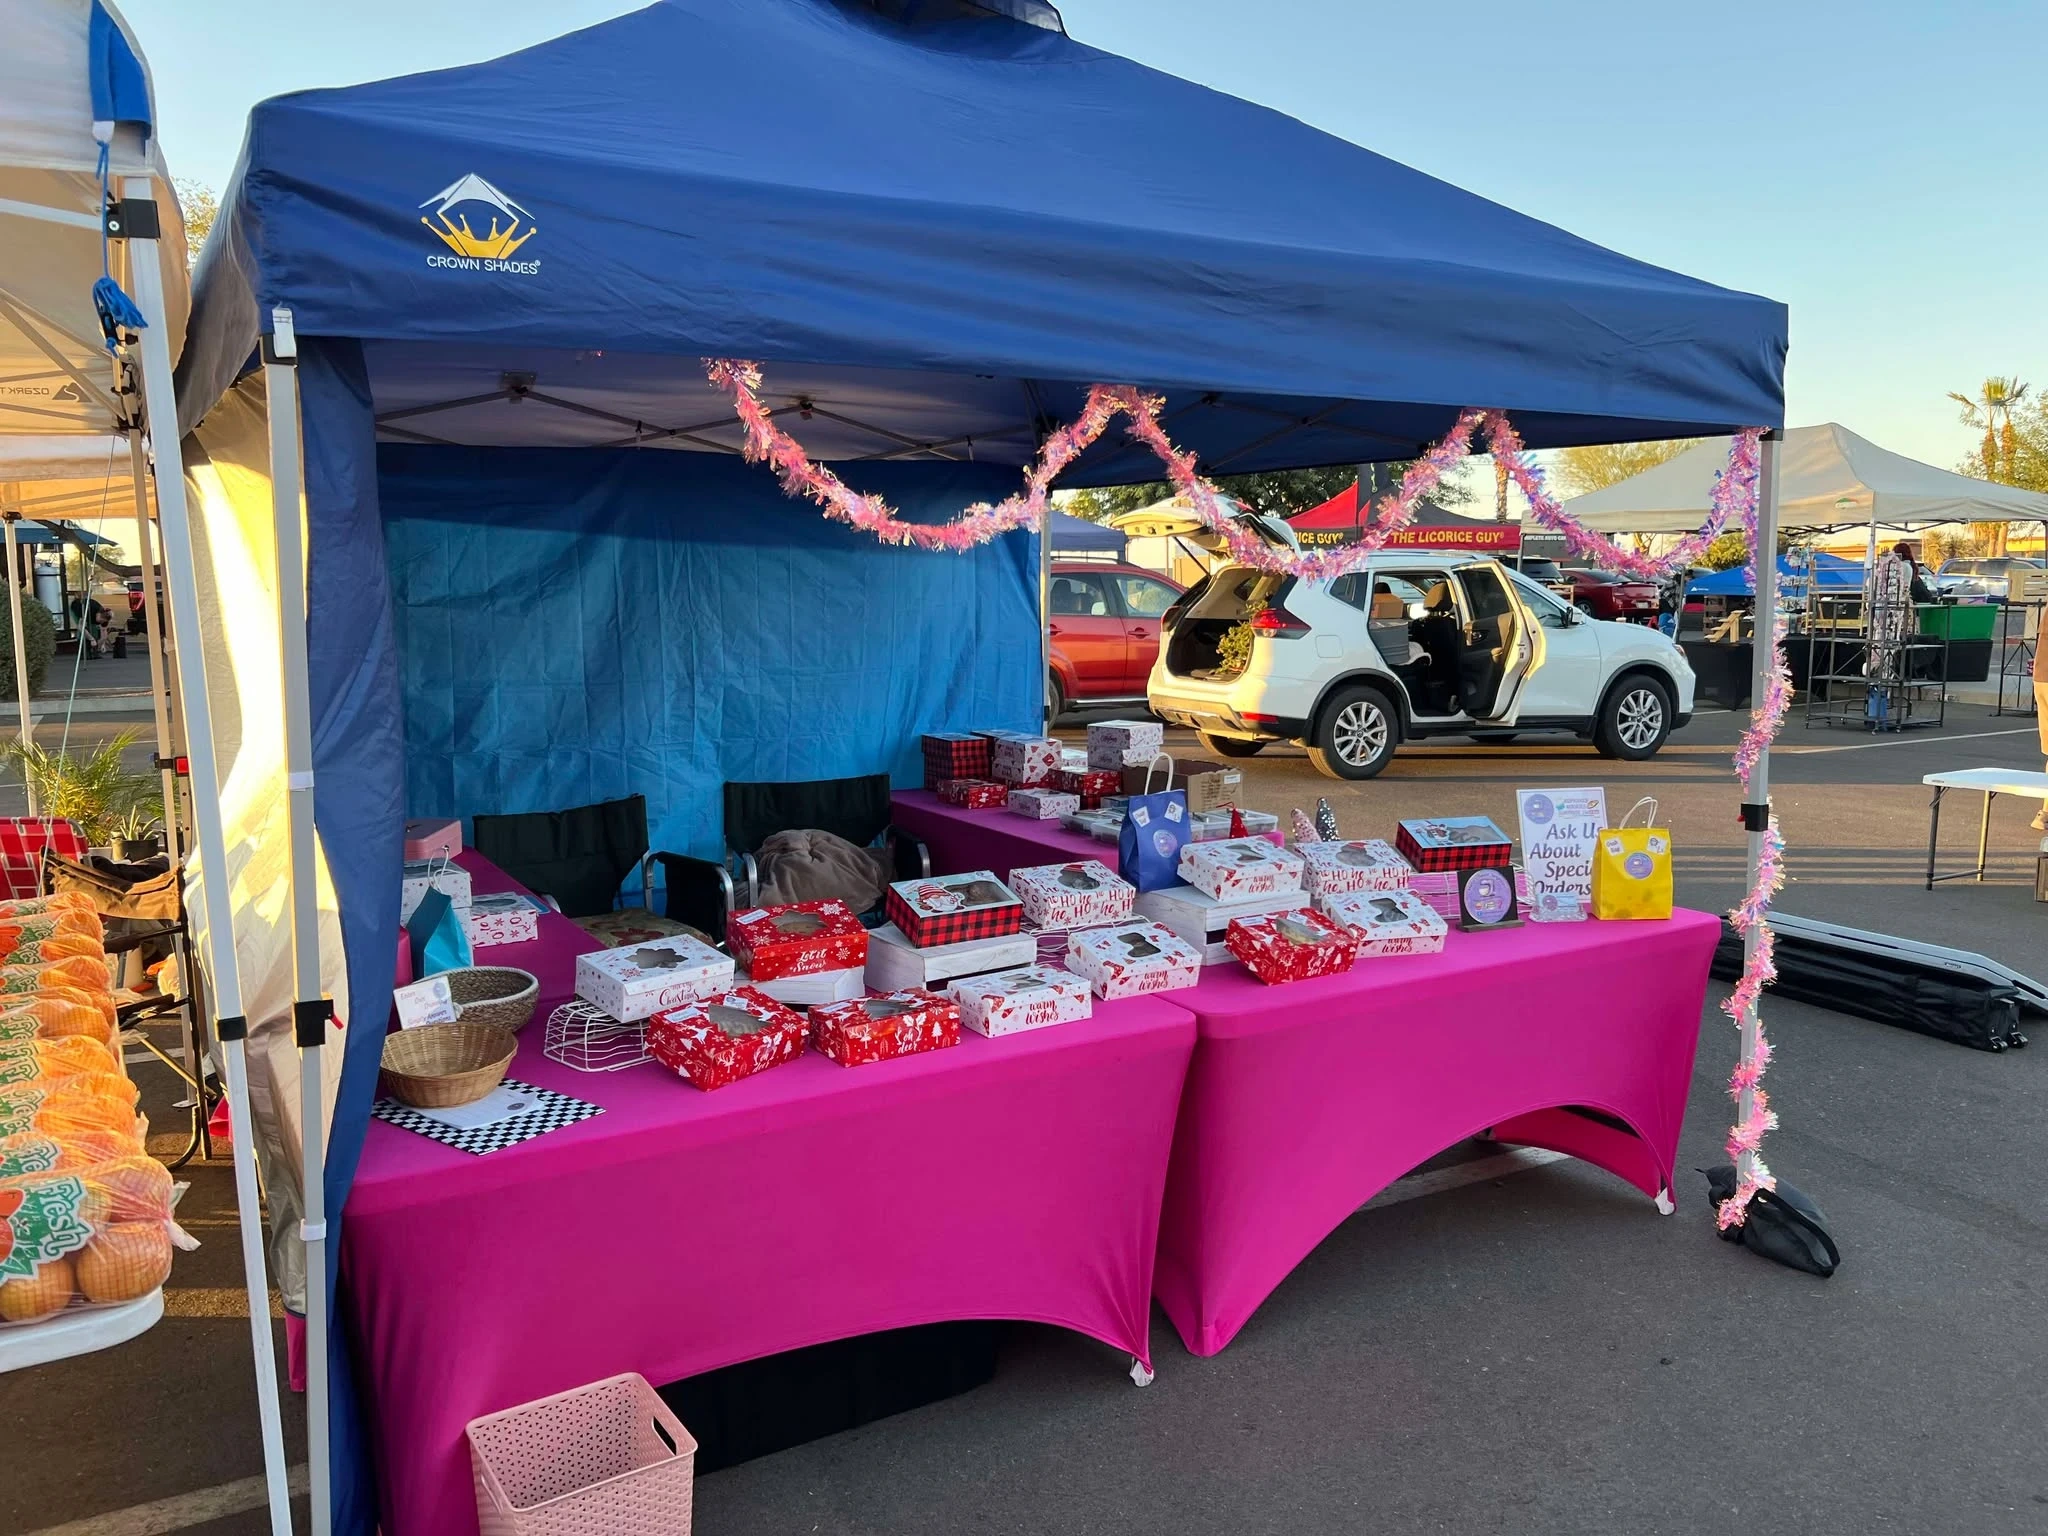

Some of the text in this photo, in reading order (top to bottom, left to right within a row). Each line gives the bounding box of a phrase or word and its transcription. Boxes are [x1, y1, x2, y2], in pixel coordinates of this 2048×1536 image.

[426, 255, 480, 271] CROWN
[1391, 531, 1416, 544] THE
[1418, 530, 1473, 543] LICORICE
[1546, 823, 1578, 840] Ask
[1529, 842, 1582, 860] About
[1544, 860, 1592, 881] Speci
[1029, 999, 1058, 1012] warm
[1025, 1009, 1059, 1025] wishes
